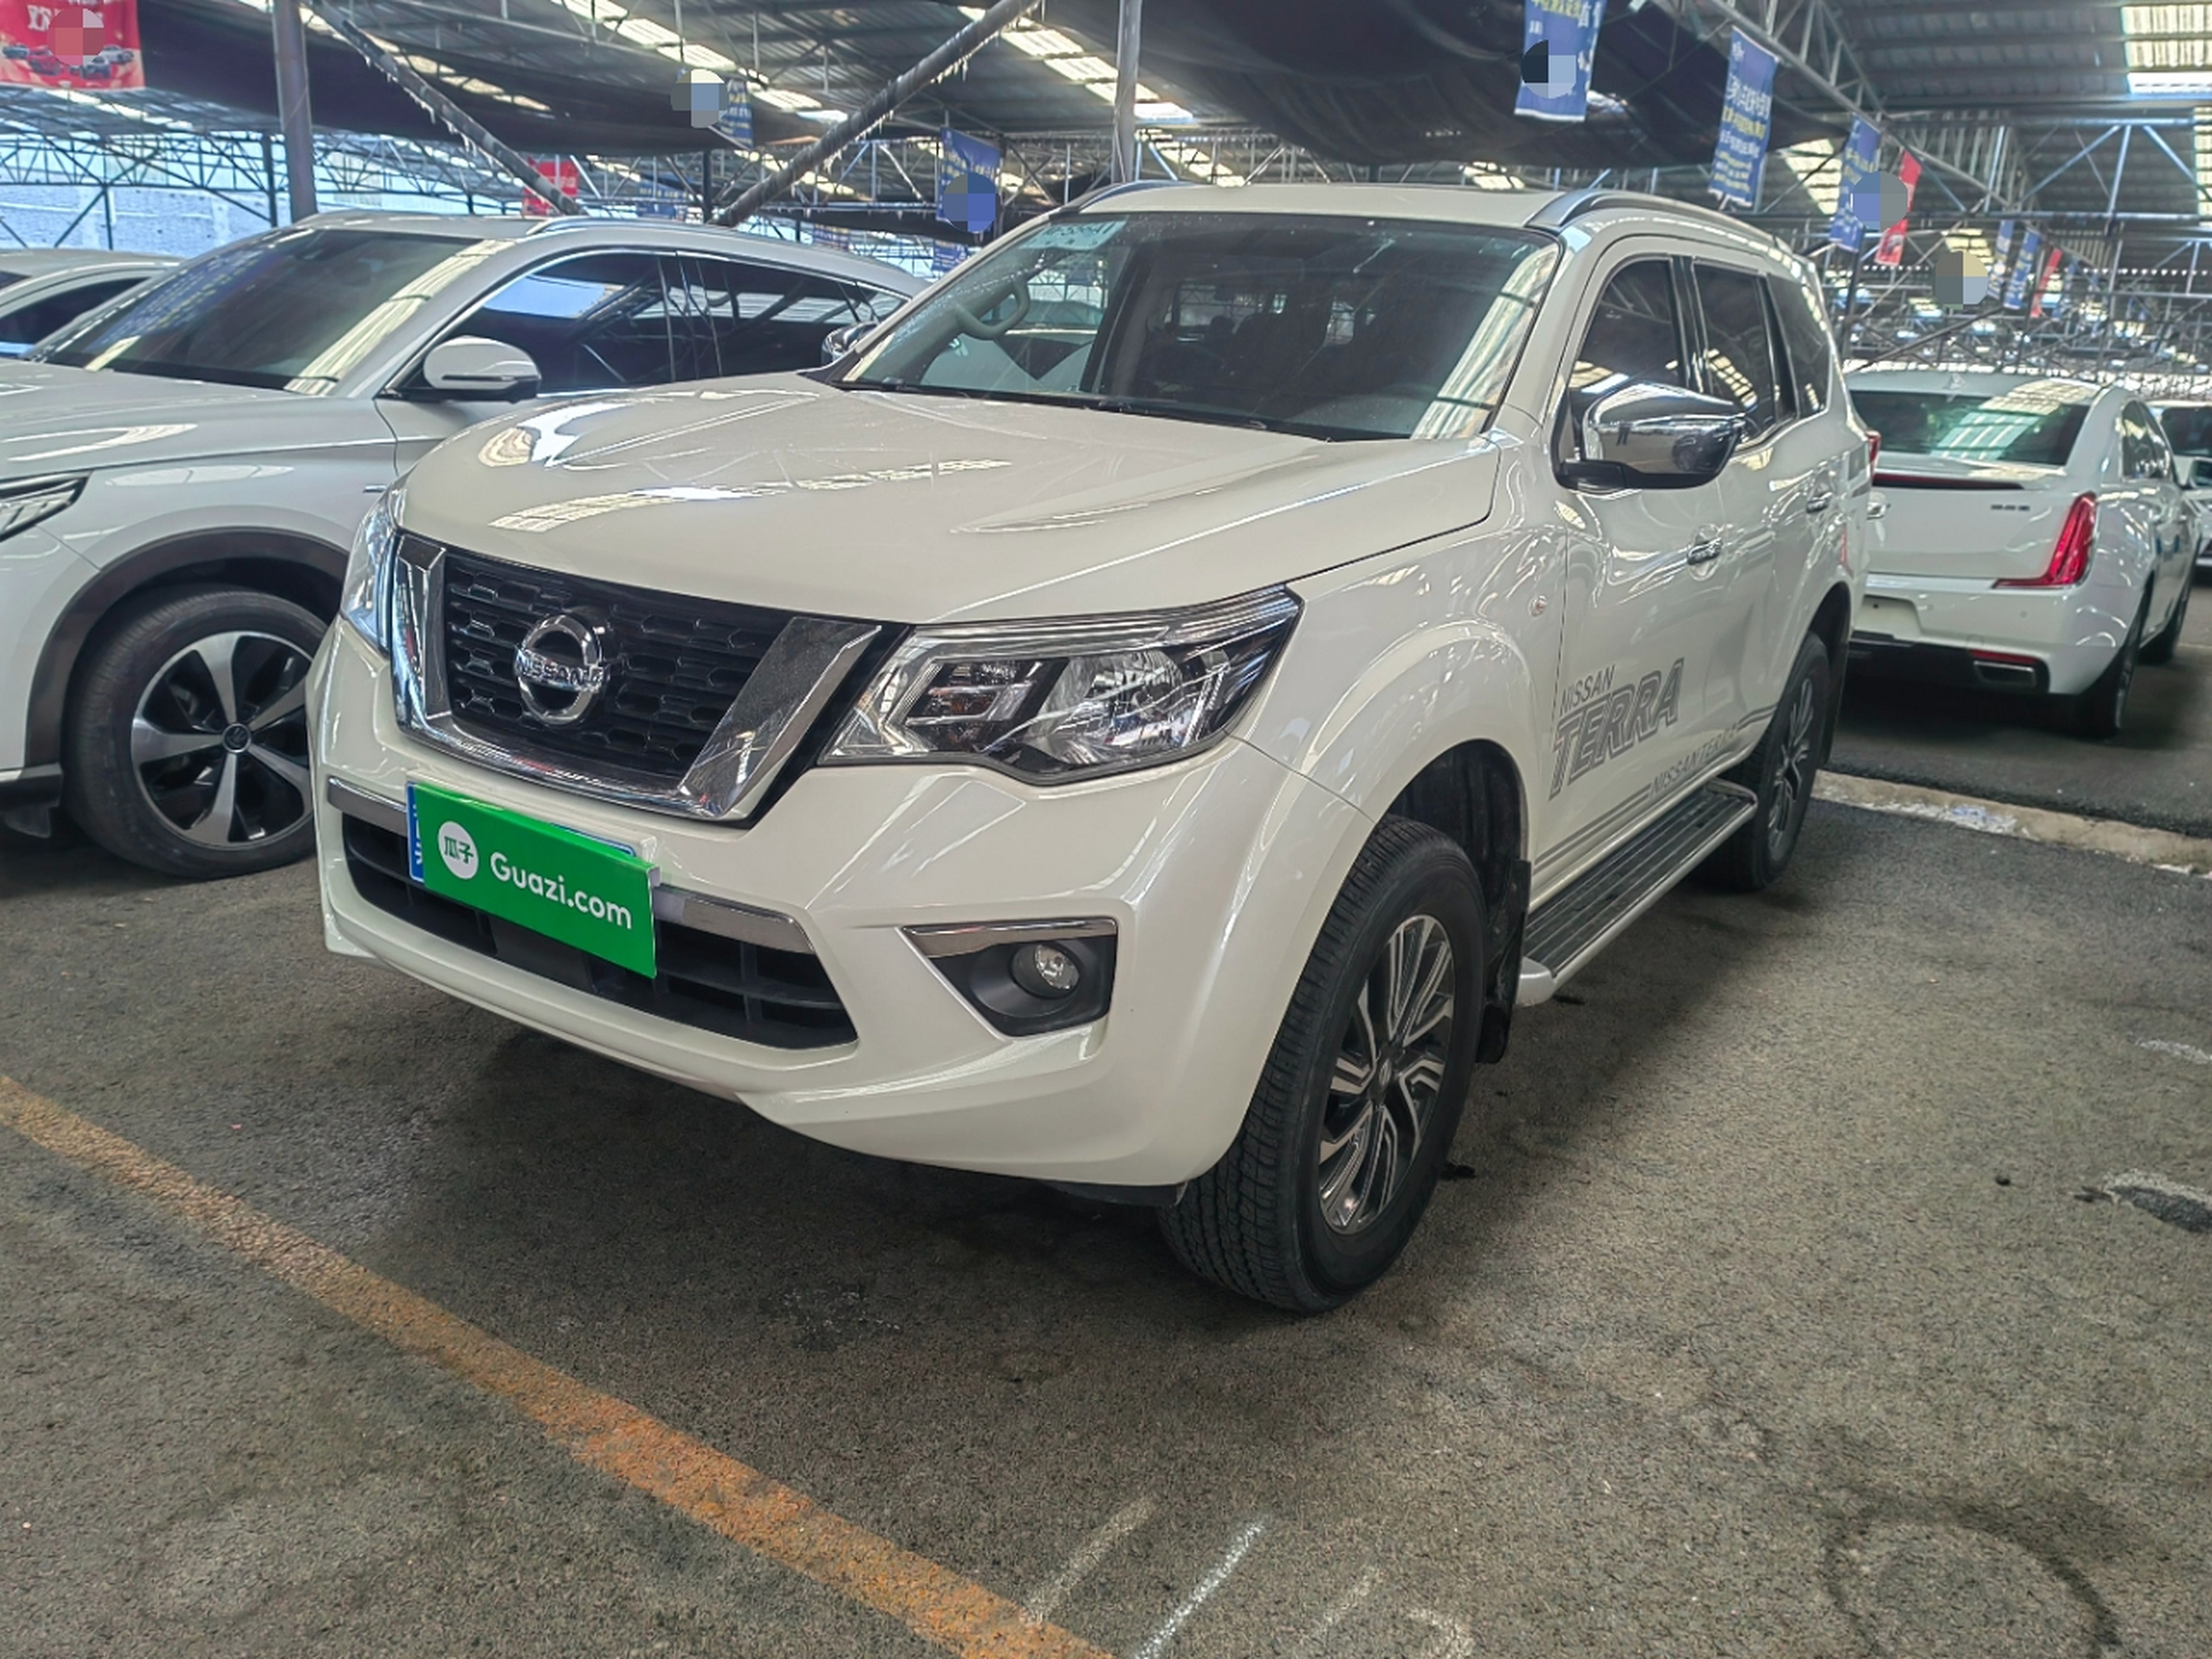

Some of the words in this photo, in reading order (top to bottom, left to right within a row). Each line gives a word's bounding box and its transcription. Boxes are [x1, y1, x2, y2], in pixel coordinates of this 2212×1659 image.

[517, 653, 584, 685] NISSAN
[1560, 665, 1616, 714] NISSAN
[1549, 657, 1685, 801] TERRA
[443, 835, 474, 865] 瓜子
[490, 852, 632, 929] Guazi.com
